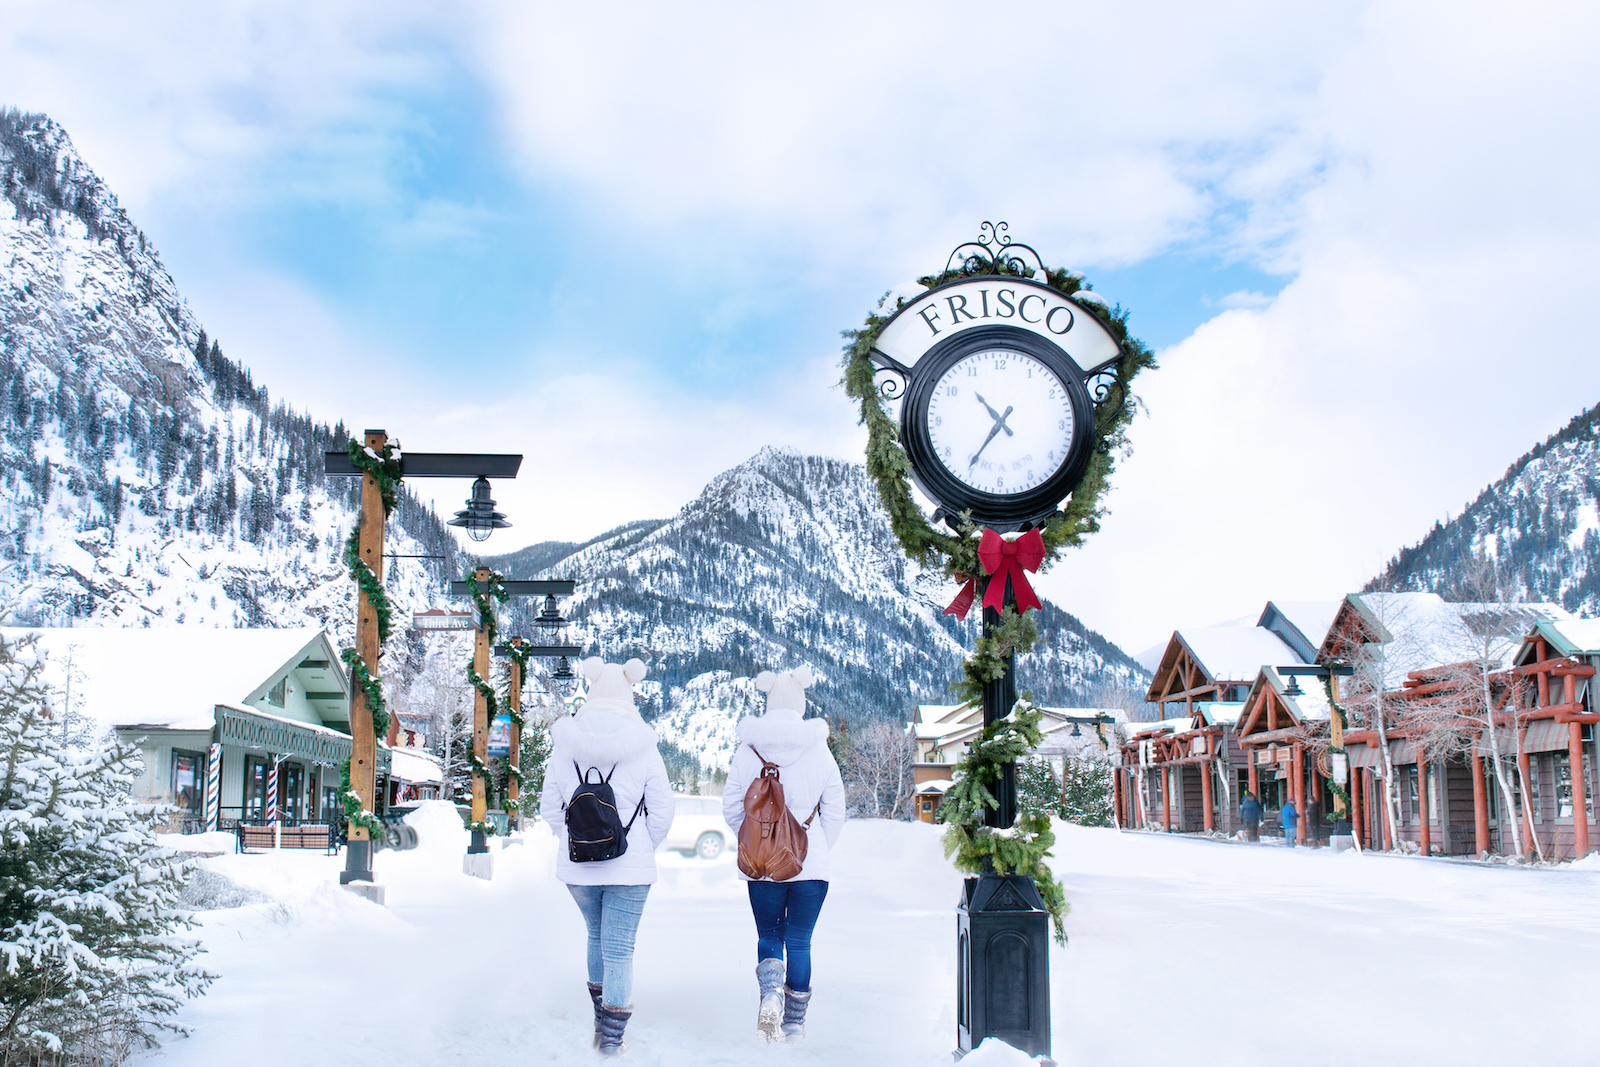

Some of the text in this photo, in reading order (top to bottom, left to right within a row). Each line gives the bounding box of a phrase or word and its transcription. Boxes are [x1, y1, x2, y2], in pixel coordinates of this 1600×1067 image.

[917, 289, 1074, 337] FRISCO
[994, 359, 1007, 370] 12
[967, 366, 977, 377] 11
[1027, 368, 1032, 379] 1
[946, 386, 958, 397] 10
[1048, 389, 1056, 400] 2
[935, 415, 942, 426] 9
[1058, 419, 1065, 431] 3
[944, 446, 952, 457] 8
[1047, 450, 1055, 460] 4
[967, 453, 1033, 472] CRCA 1879
[967, 468, 974, 479] 7
[1027, 469, 1034, 480] 5
[996, 476, 1004, 488] 6
[423, 617, 468, 628] Third Ave
